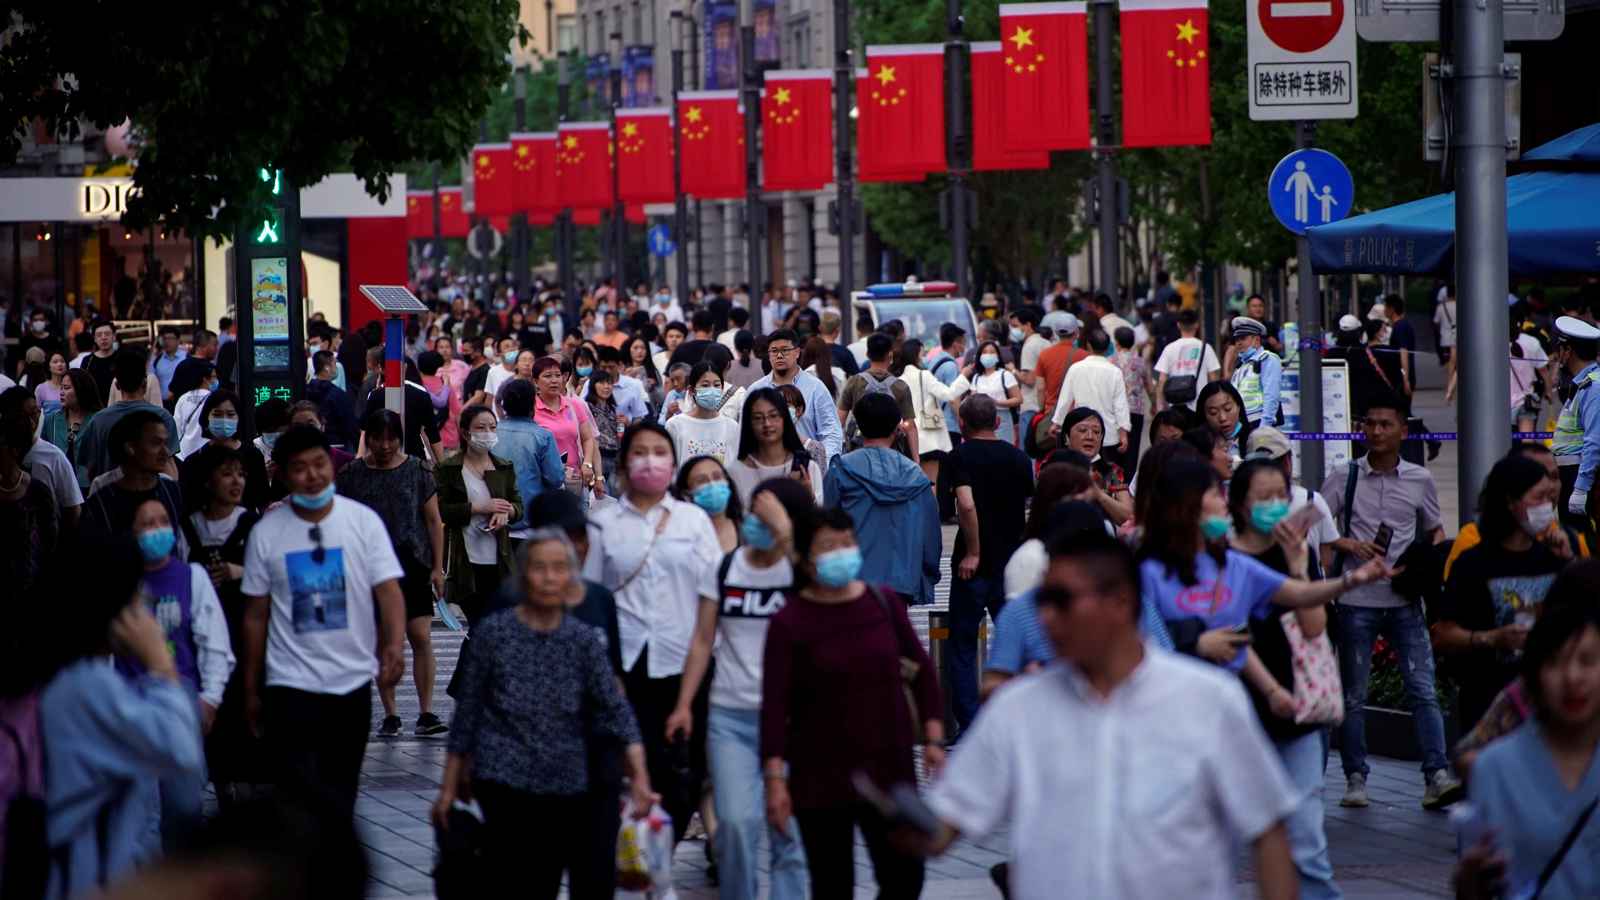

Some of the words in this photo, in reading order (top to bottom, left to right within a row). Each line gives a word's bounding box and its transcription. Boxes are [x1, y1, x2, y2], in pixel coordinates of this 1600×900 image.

[1259, 69, 1346, 96] 除特种车辆外
[1360, 237, 1399, 267] POLICE
[723, 588, 786, 615] FILA
